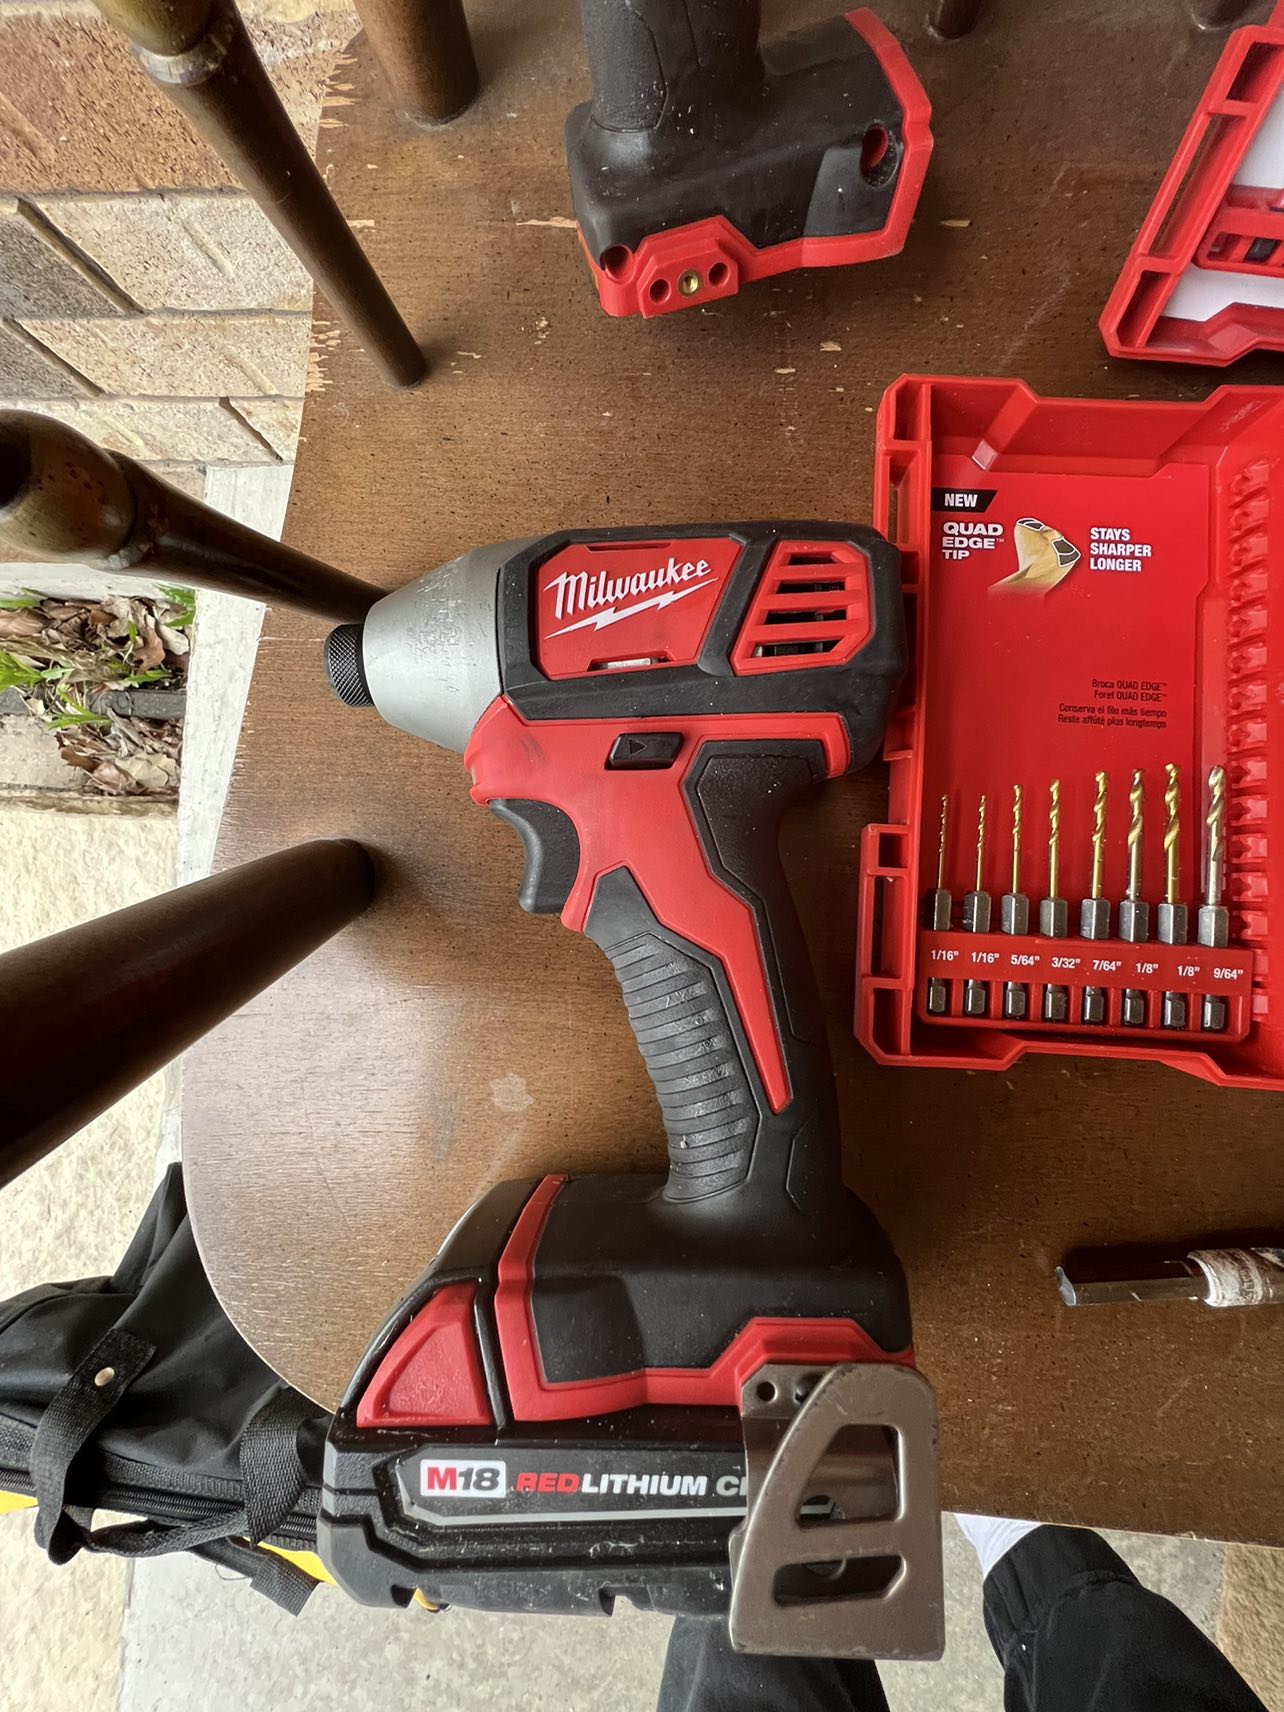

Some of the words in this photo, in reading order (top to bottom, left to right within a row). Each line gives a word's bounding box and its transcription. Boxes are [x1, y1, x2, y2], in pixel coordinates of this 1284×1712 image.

[944, 493, 978, 508] NEW
[943, 521, 1004, 536] QUAD
[1090, 527, 1131, 542] STAYS
[942, 549, 970, 560] TIP
[1090, 542, 1152, 557] SHARPER
[1089, 557, 1142, 572] LONGER
[543, 557, 713, 620] Milwaukee
[1091, 679, 1115, 689] Broca
[1116, 680, 1139, 690] QUAD
[1094, 690, 1115, 700] Foret
[1116, 691, 1139, 701] QUAD
[1059, 703, 1096, 714] Conserva
[1097, 705, 1105, 714] el
[1107, 705, 1119, 715] filo
[1120, 706, 1138, 717] más
[1140, 707, 1167, 719] tiempo
[1058, 714, 1080, 724] Reste
[1106, 717, 1124, 727] plus
[1125, 718, 1168, 730] longtemps
[426, 1466, 500, 1491] M18
[516, 1472, 708, 1497] REDLITHIUM
